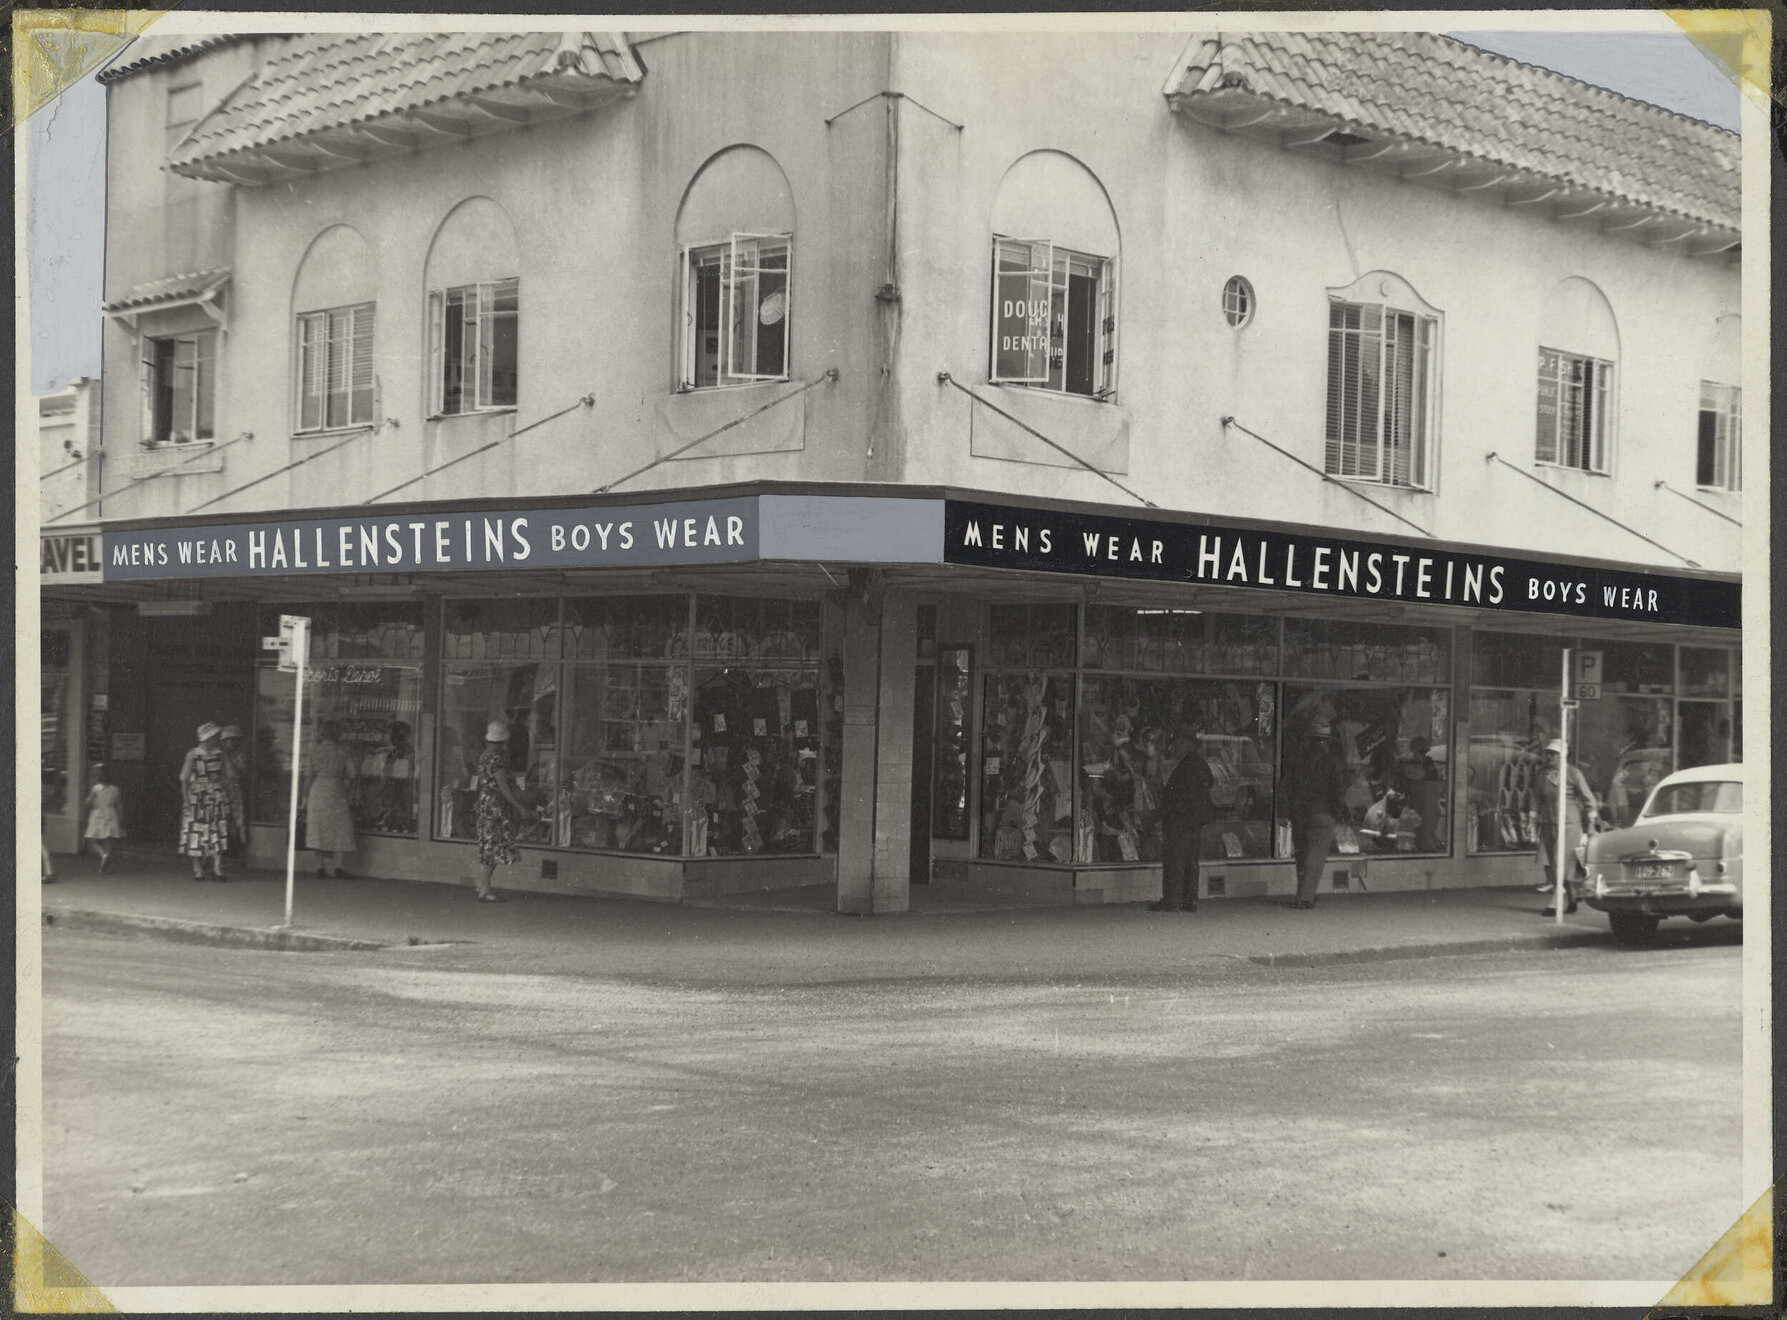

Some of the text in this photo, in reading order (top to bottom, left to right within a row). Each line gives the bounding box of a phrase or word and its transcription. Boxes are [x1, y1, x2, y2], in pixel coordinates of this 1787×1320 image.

[112, 515, 746, 570] MENS WEAR HALLENSTEINS BOYS WEAR
[964, 521, 1659, 613] MENS WEAR HALLENSTEINS BOYS WEAR
[1581, 655, 1596, 679] P
[1579, 685, 1597, 698] 60
